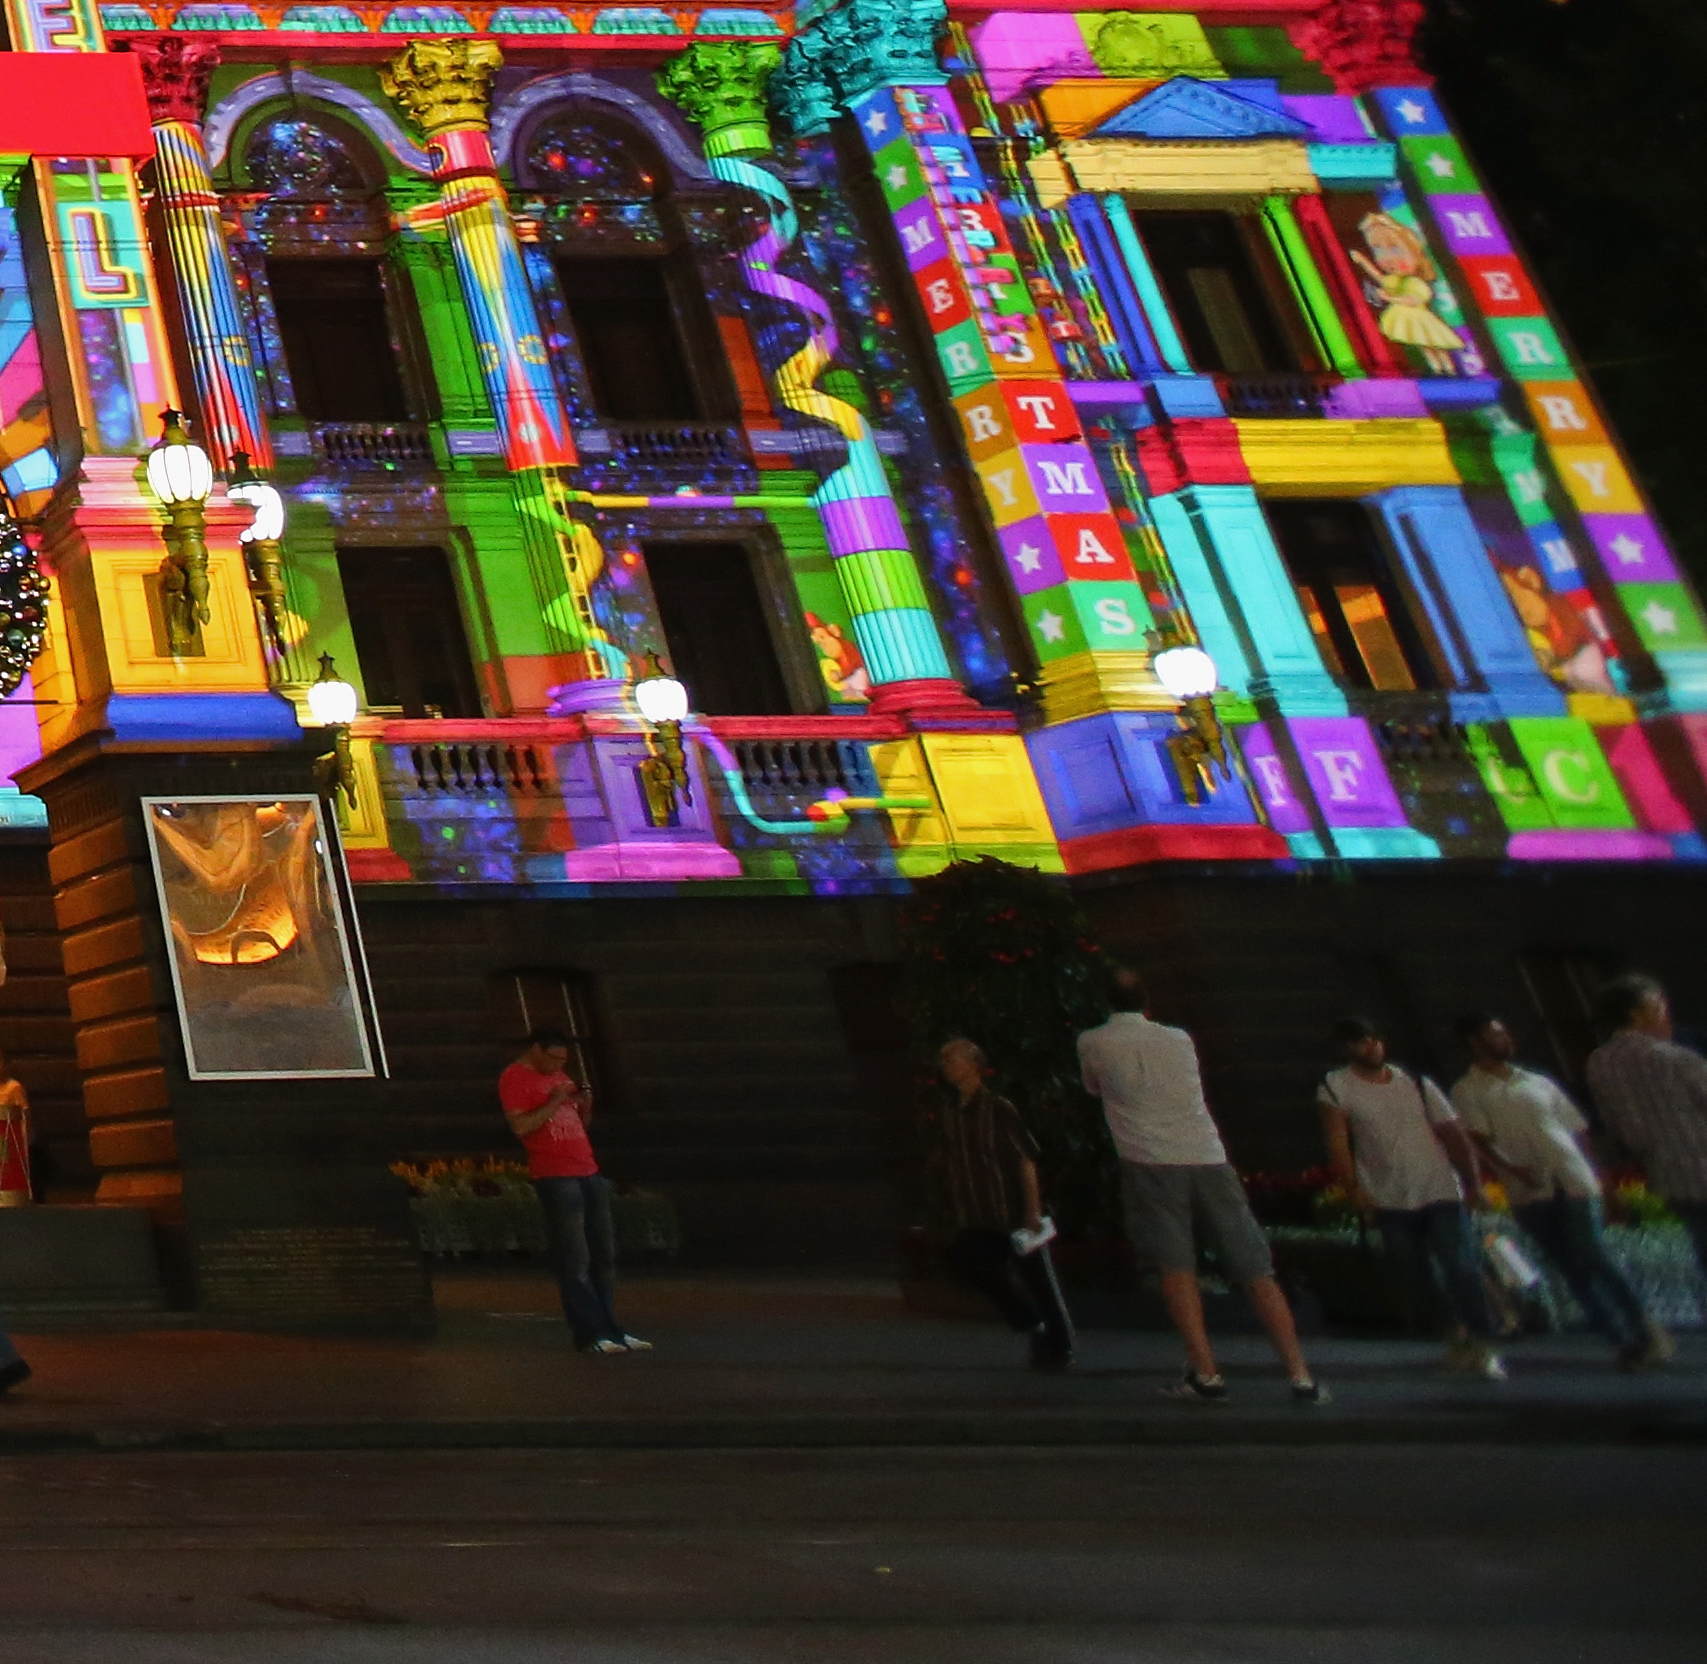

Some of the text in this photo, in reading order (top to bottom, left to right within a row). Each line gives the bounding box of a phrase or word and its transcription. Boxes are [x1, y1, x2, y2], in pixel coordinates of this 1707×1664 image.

[900, 216, 1019, 507] MERRY
[1447, 211, 1612, 498] MERRY
[1313, 750, 1365, 802] F
[1542, 749, 1600, 804] C
